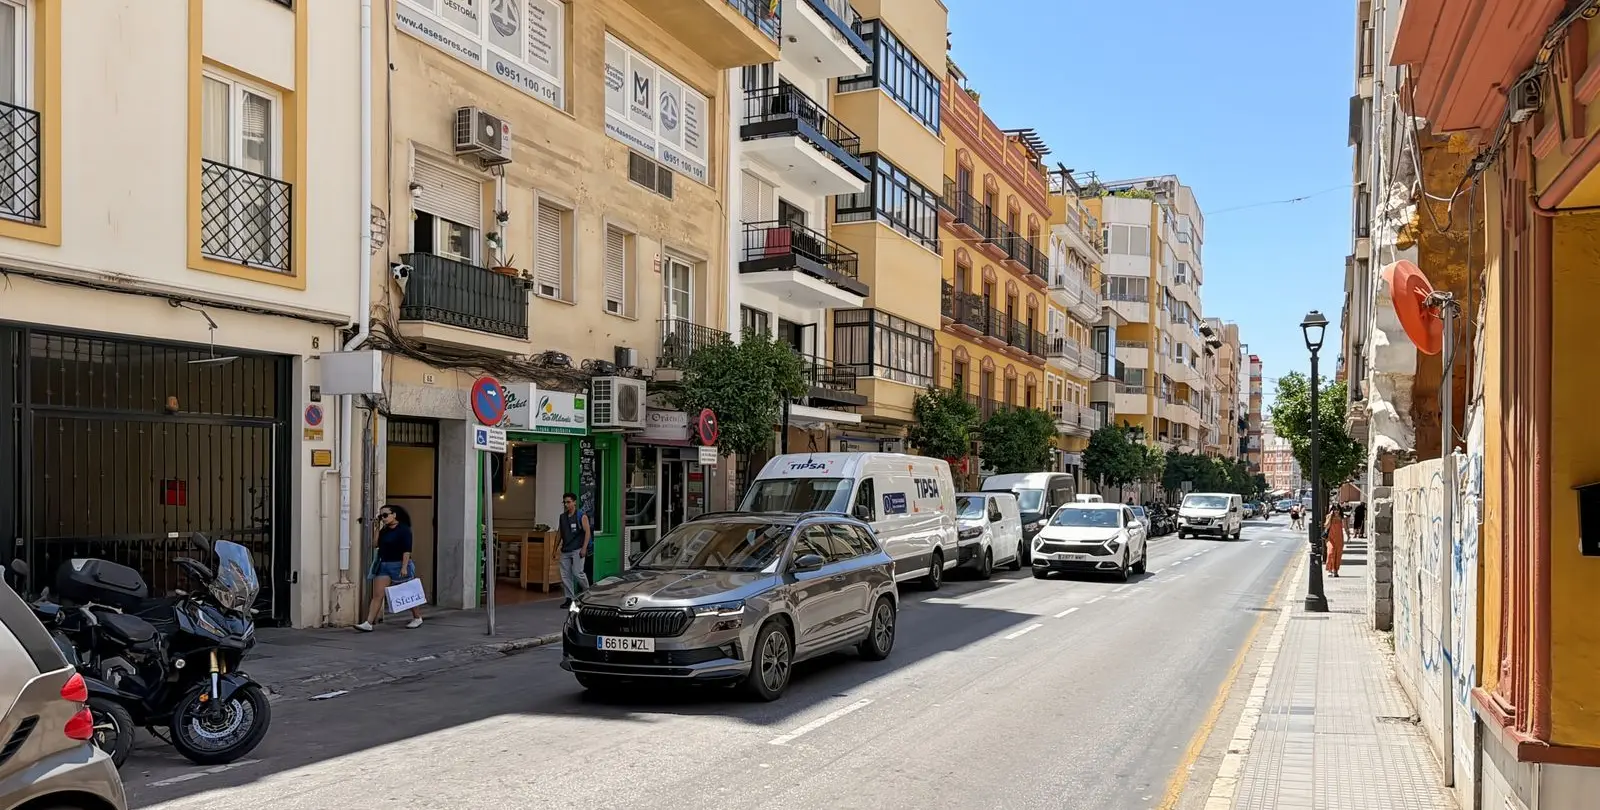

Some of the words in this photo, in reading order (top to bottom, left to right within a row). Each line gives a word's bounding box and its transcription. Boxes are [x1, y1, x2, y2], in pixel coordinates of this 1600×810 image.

[504, 67, 520, 83] 951
[523, 76, 539, 93] 100
[542, 86, 556, 101] 101
[681, 160, 691, 173] 100
[312, 336, 319, 349] 6
[914, 478, 940, 499] TIPSA
[605, 637, 628, 650] 6616
[630, 638, 649, 651] MZL
